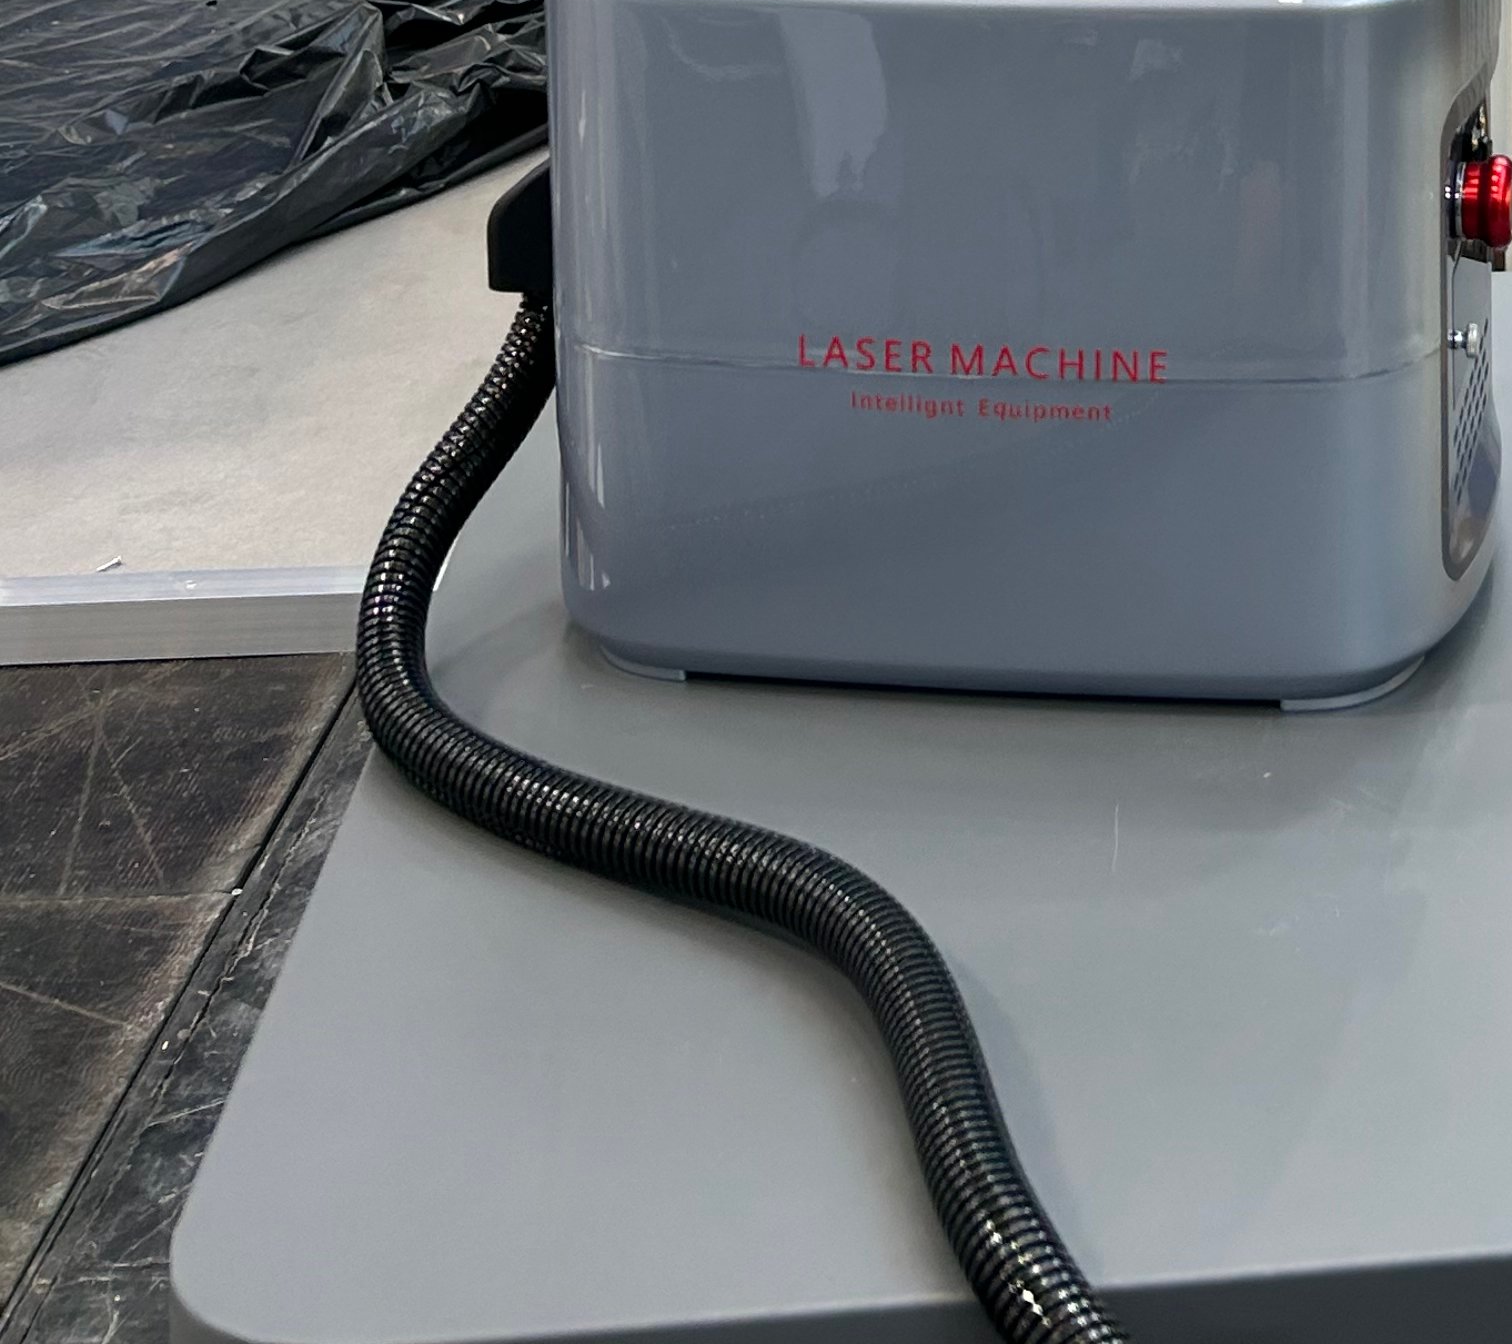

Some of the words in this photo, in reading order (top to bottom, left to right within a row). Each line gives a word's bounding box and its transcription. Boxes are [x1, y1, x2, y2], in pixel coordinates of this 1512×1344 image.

[798, 333, 935, 374] LASER
[949, 342, 1169, 385] MACHINE
[976, 398, 1113, 423] Equipment
